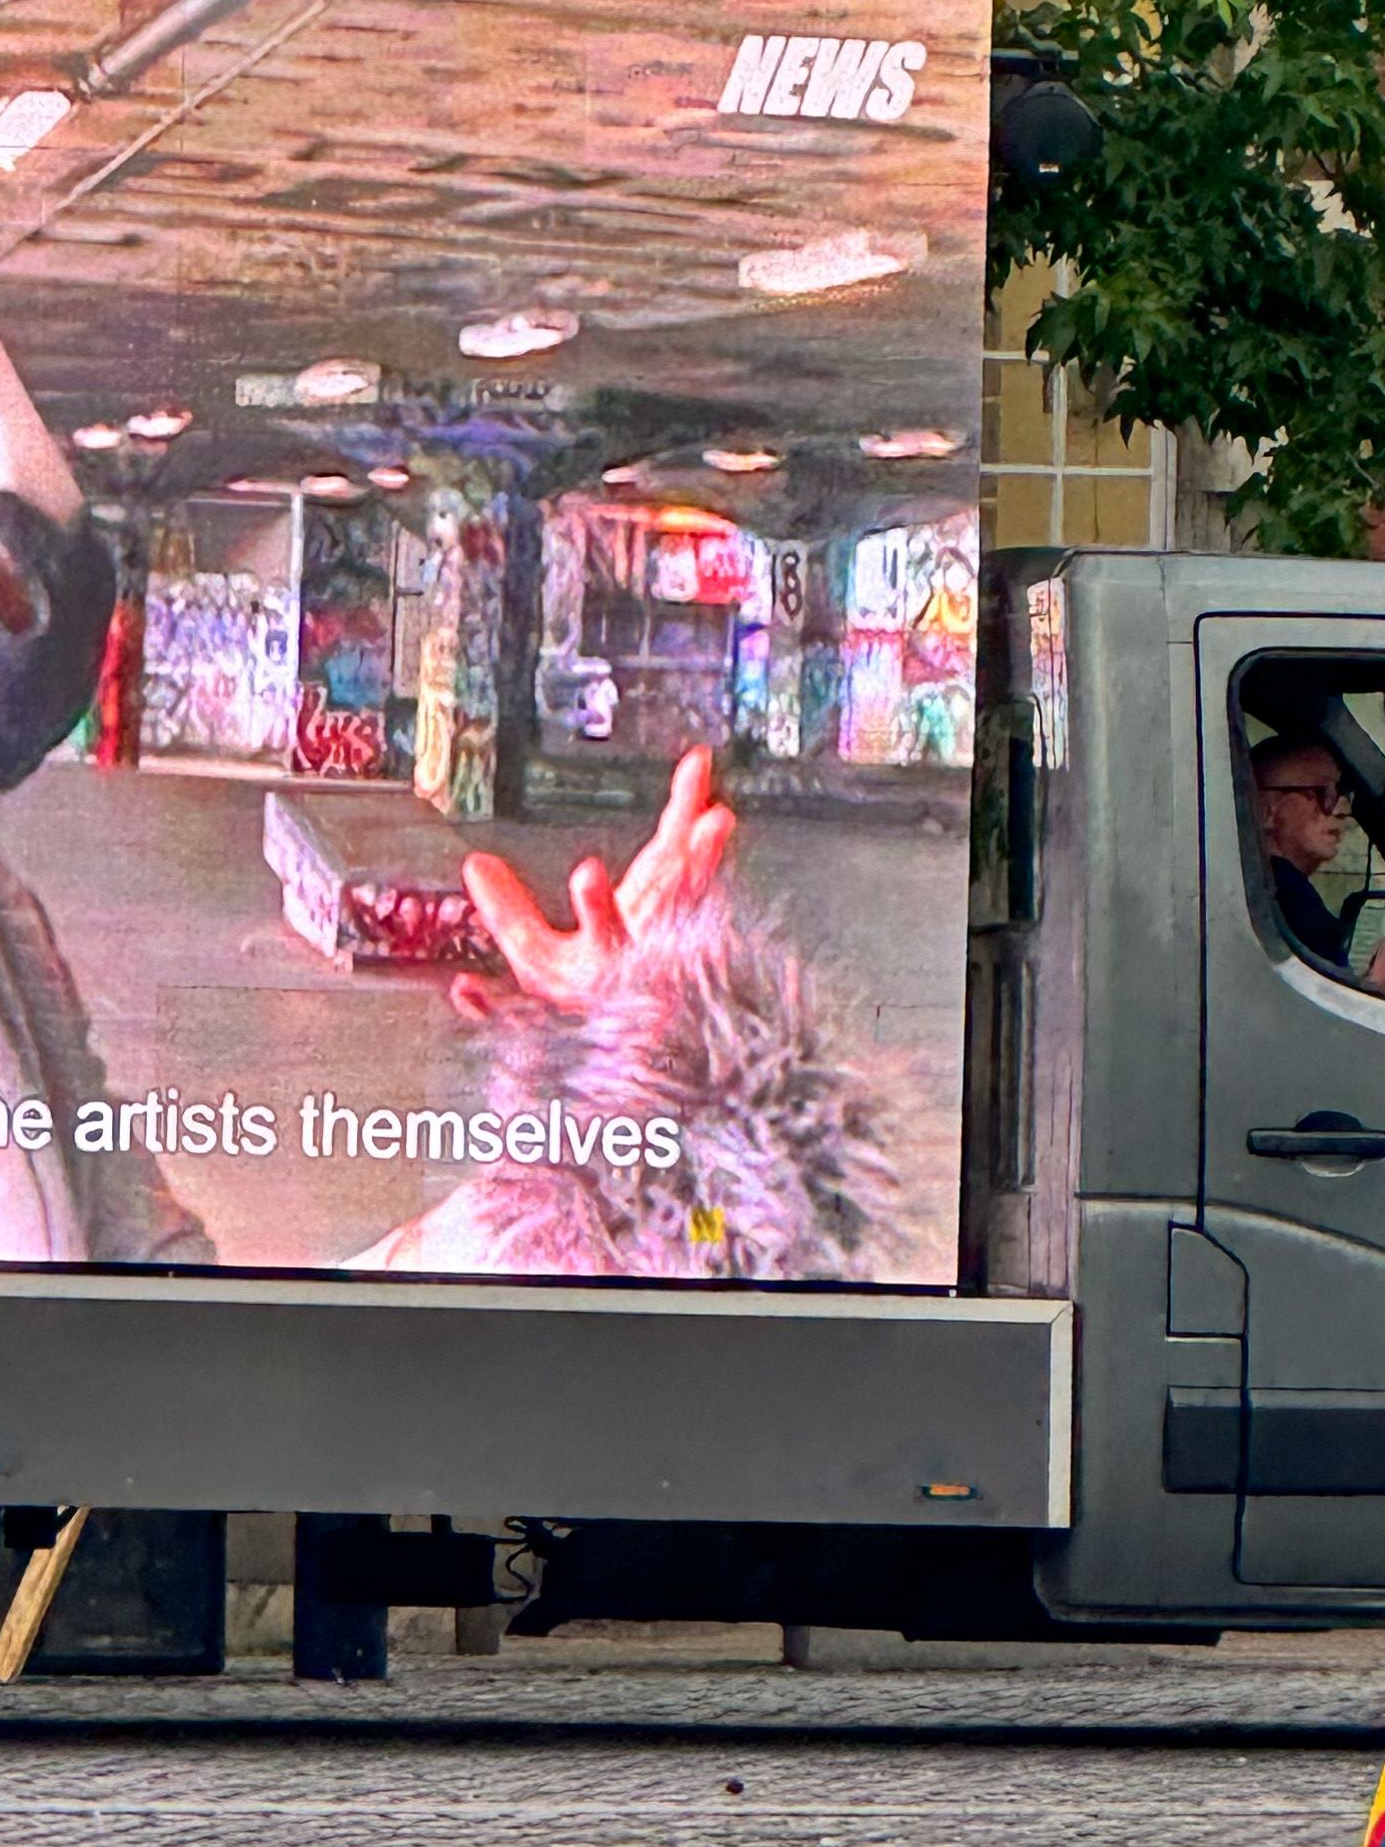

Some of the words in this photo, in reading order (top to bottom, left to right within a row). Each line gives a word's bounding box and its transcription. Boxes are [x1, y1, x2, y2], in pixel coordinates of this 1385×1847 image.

[717, 34, 927, 120] NEWS
[73, 1087, 278, 1156] artists
[299, 1091, 682, 1170] themselves
